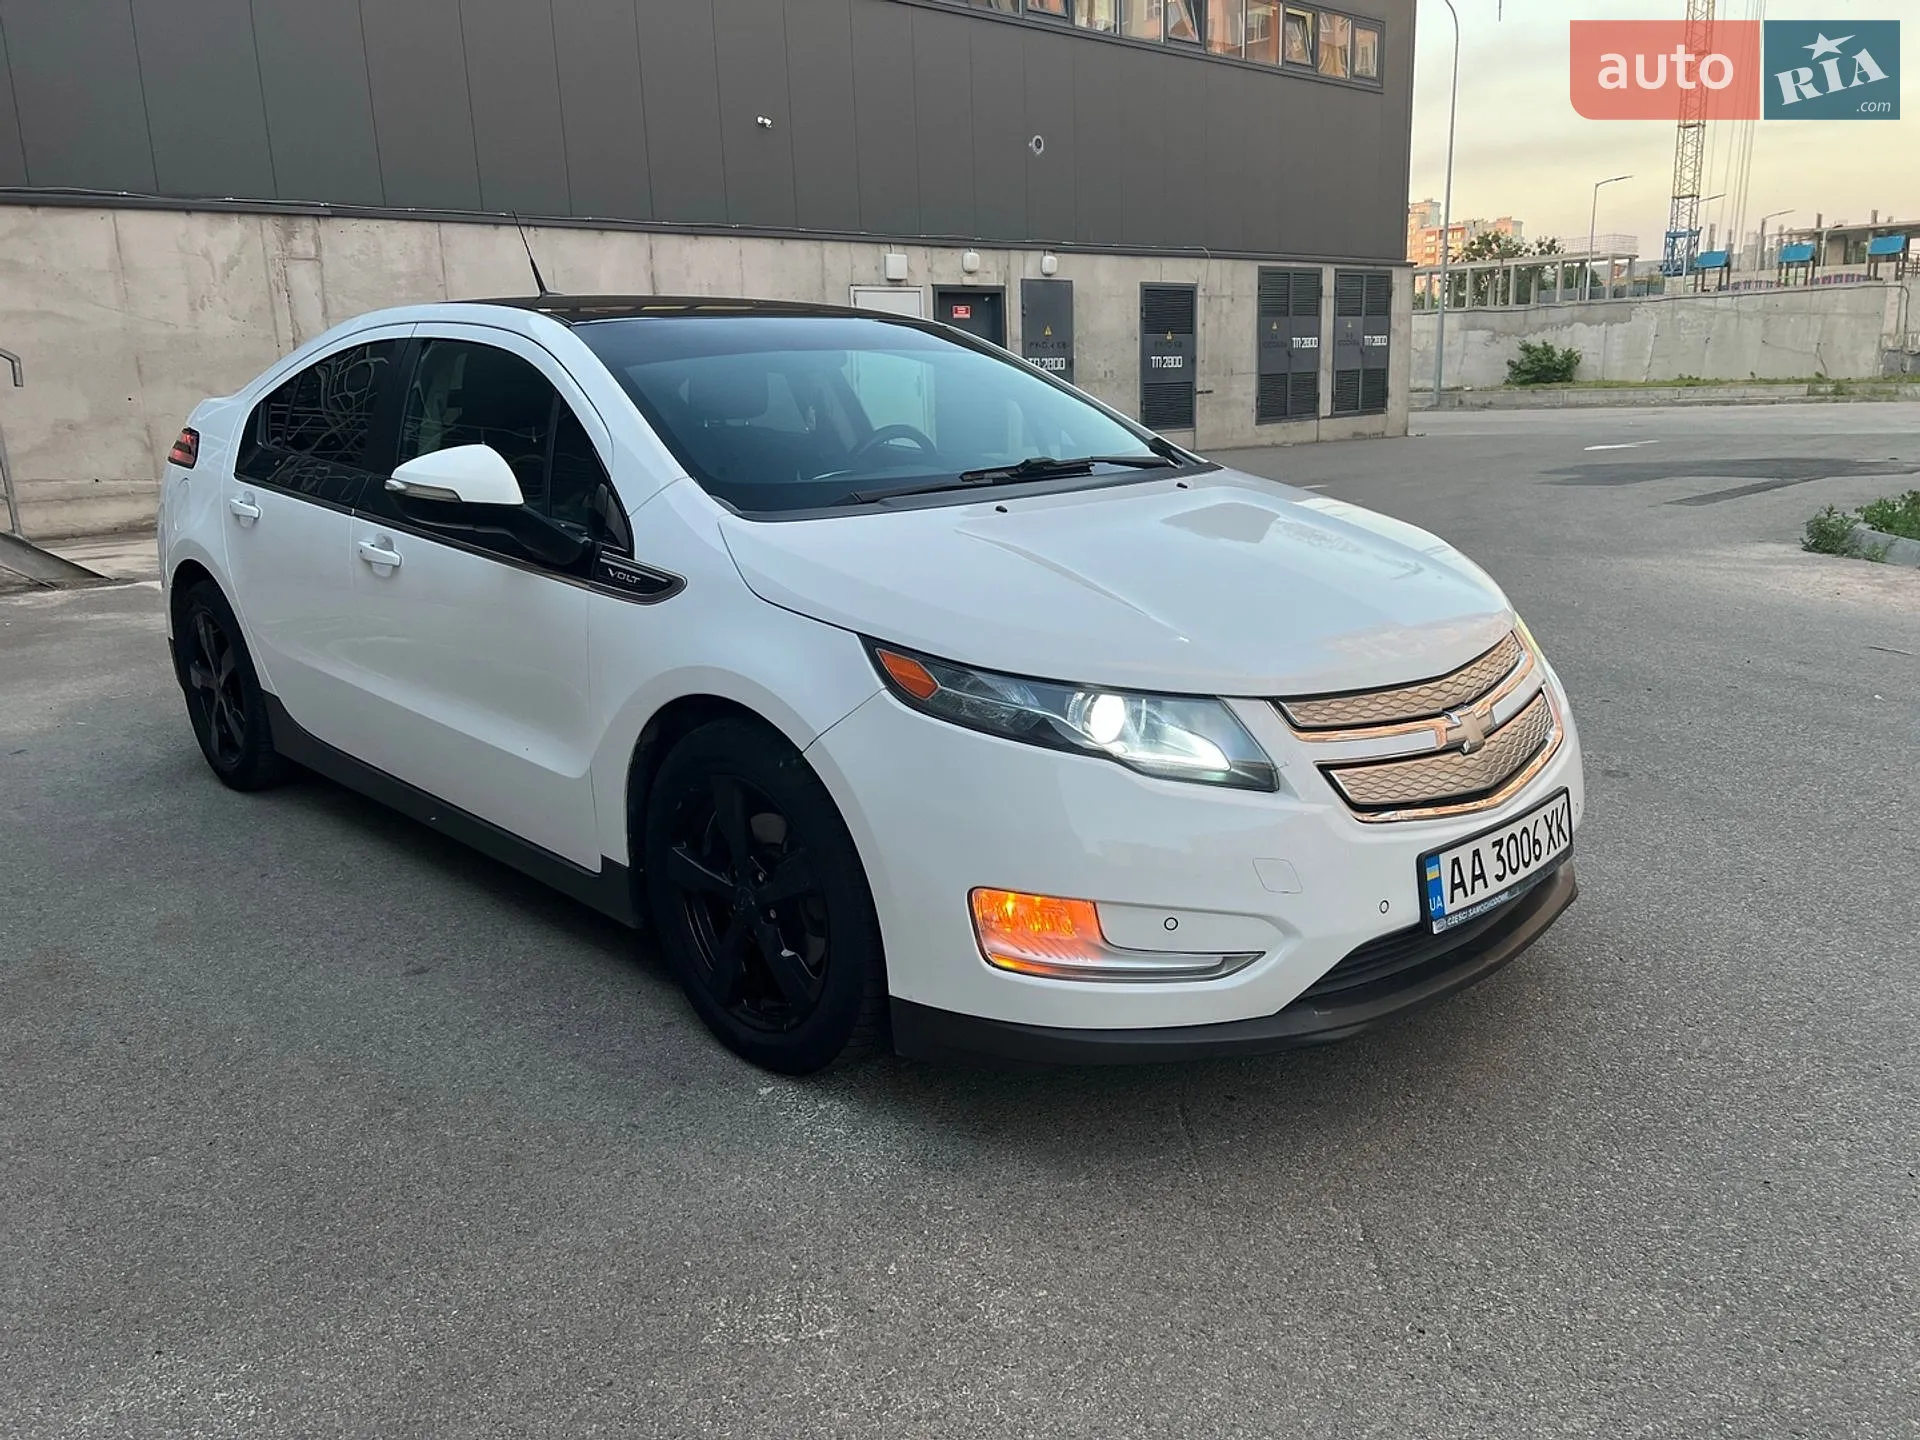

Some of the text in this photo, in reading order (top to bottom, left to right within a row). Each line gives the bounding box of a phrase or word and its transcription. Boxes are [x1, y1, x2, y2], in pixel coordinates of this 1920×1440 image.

[608, 567, 641, 584] VOLT
[1450, 802, 1568, 904] AA 3006 XK
[1429, 896, 1443, 911] UA
